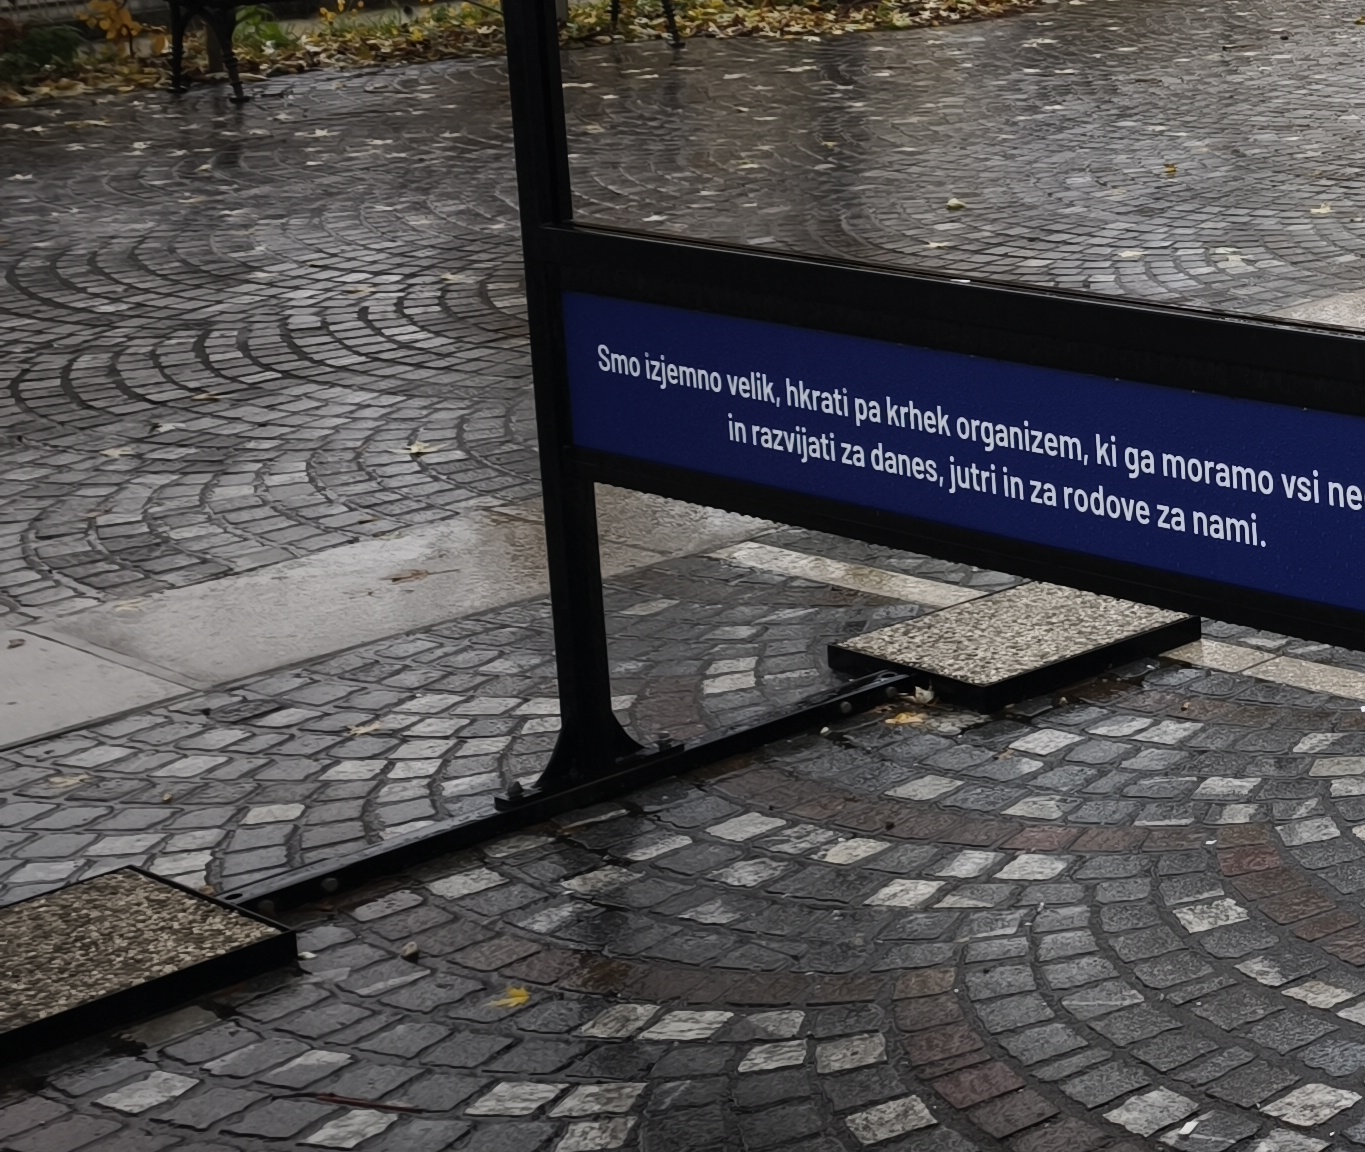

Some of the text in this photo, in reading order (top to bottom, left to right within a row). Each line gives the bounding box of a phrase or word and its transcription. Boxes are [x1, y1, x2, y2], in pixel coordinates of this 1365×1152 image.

[598, 345, 640, 376] Smo
[645, 353, 721, 392] izjemno
[727, 372, 780, 407] velik,
[786, 378, 848, 416] hkrati
[855, 398, 880, 426] pa
[886, 397, 950, 436] krhek
[957, 417, 1088, 465] organizem,
[1096, 434, 1116, 467] ki
[1125, 447, 1154, 478] ga
[1163, 454, 1273, 494] moramo
[1281, 470, 1319, 503] vsi
[728, 413, 1266, 547] in razvijati za danes, jutri in za rodove za nami.
